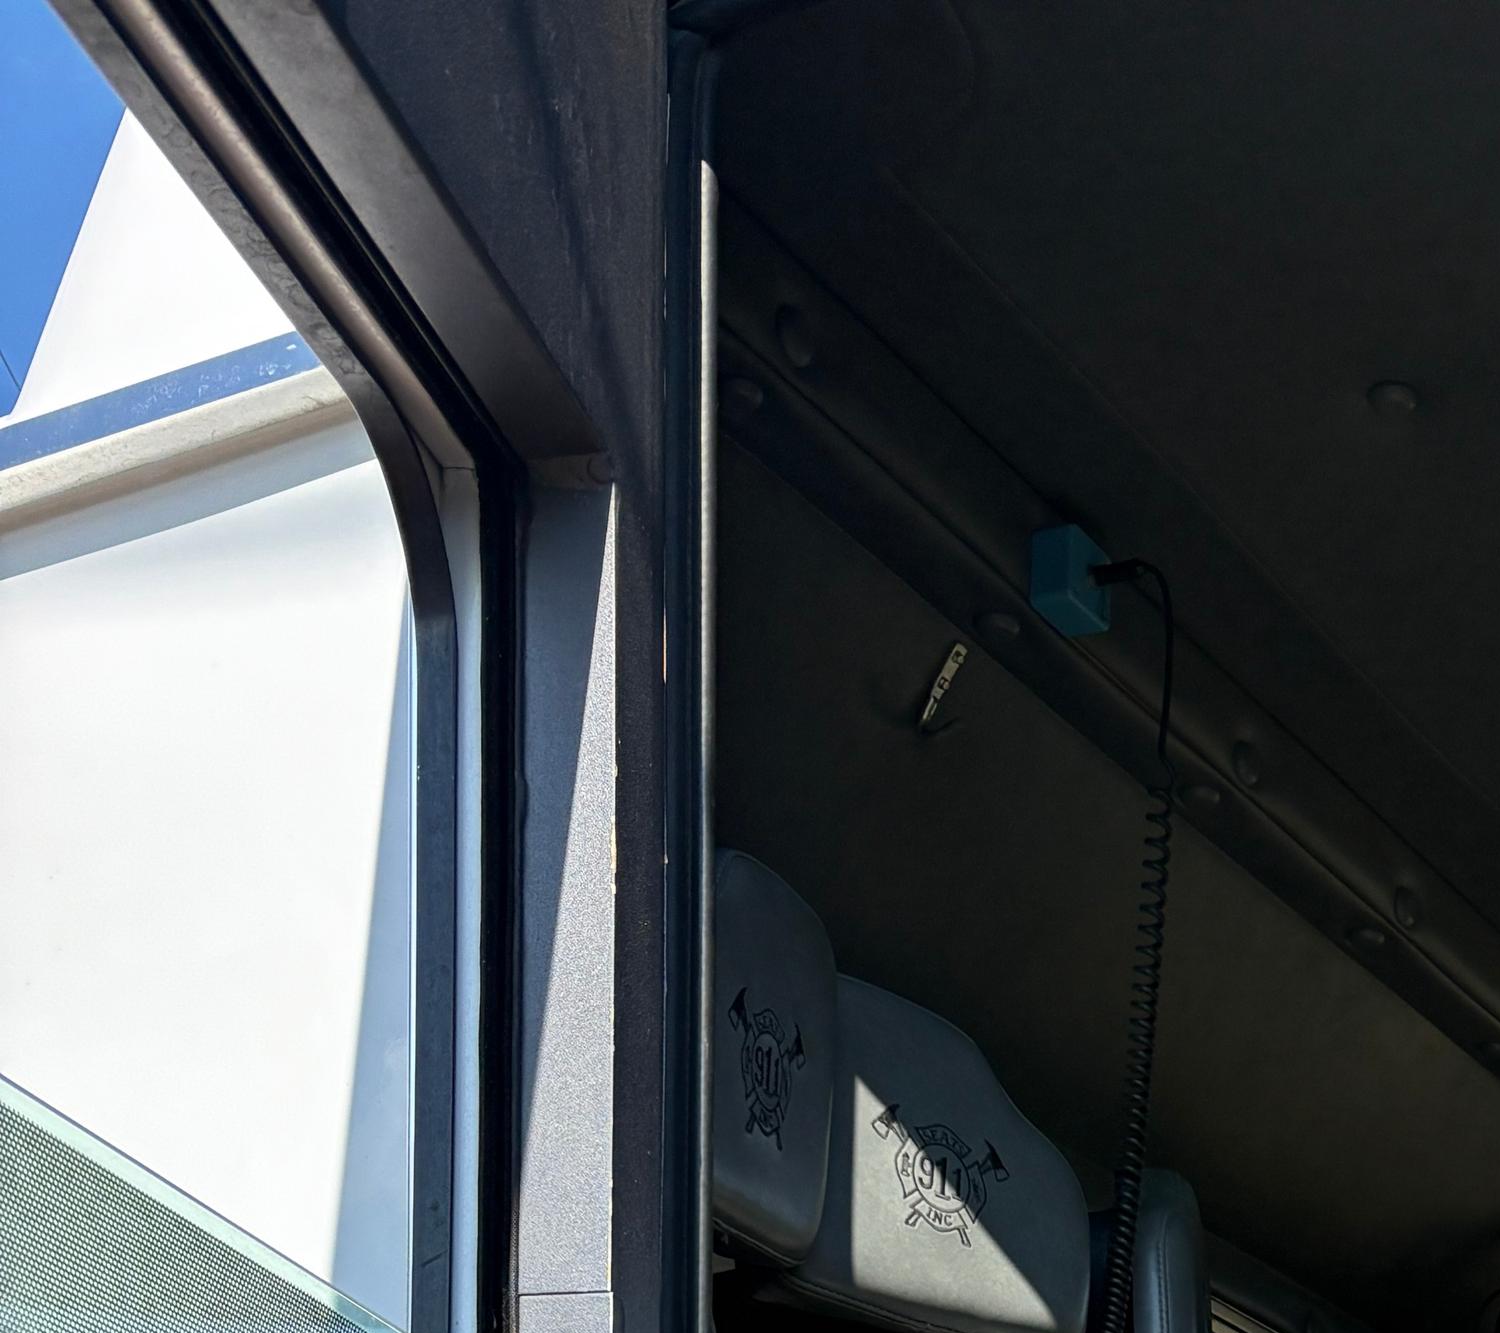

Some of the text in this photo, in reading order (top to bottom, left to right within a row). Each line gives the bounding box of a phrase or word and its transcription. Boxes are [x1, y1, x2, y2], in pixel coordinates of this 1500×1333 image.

[755, 1045, 780, 1098] 911
[921, 1129, 968, 1155] SEATS
[918, 1156, 963, 1200] 911
[926, 1208, 953, 1227] INC
